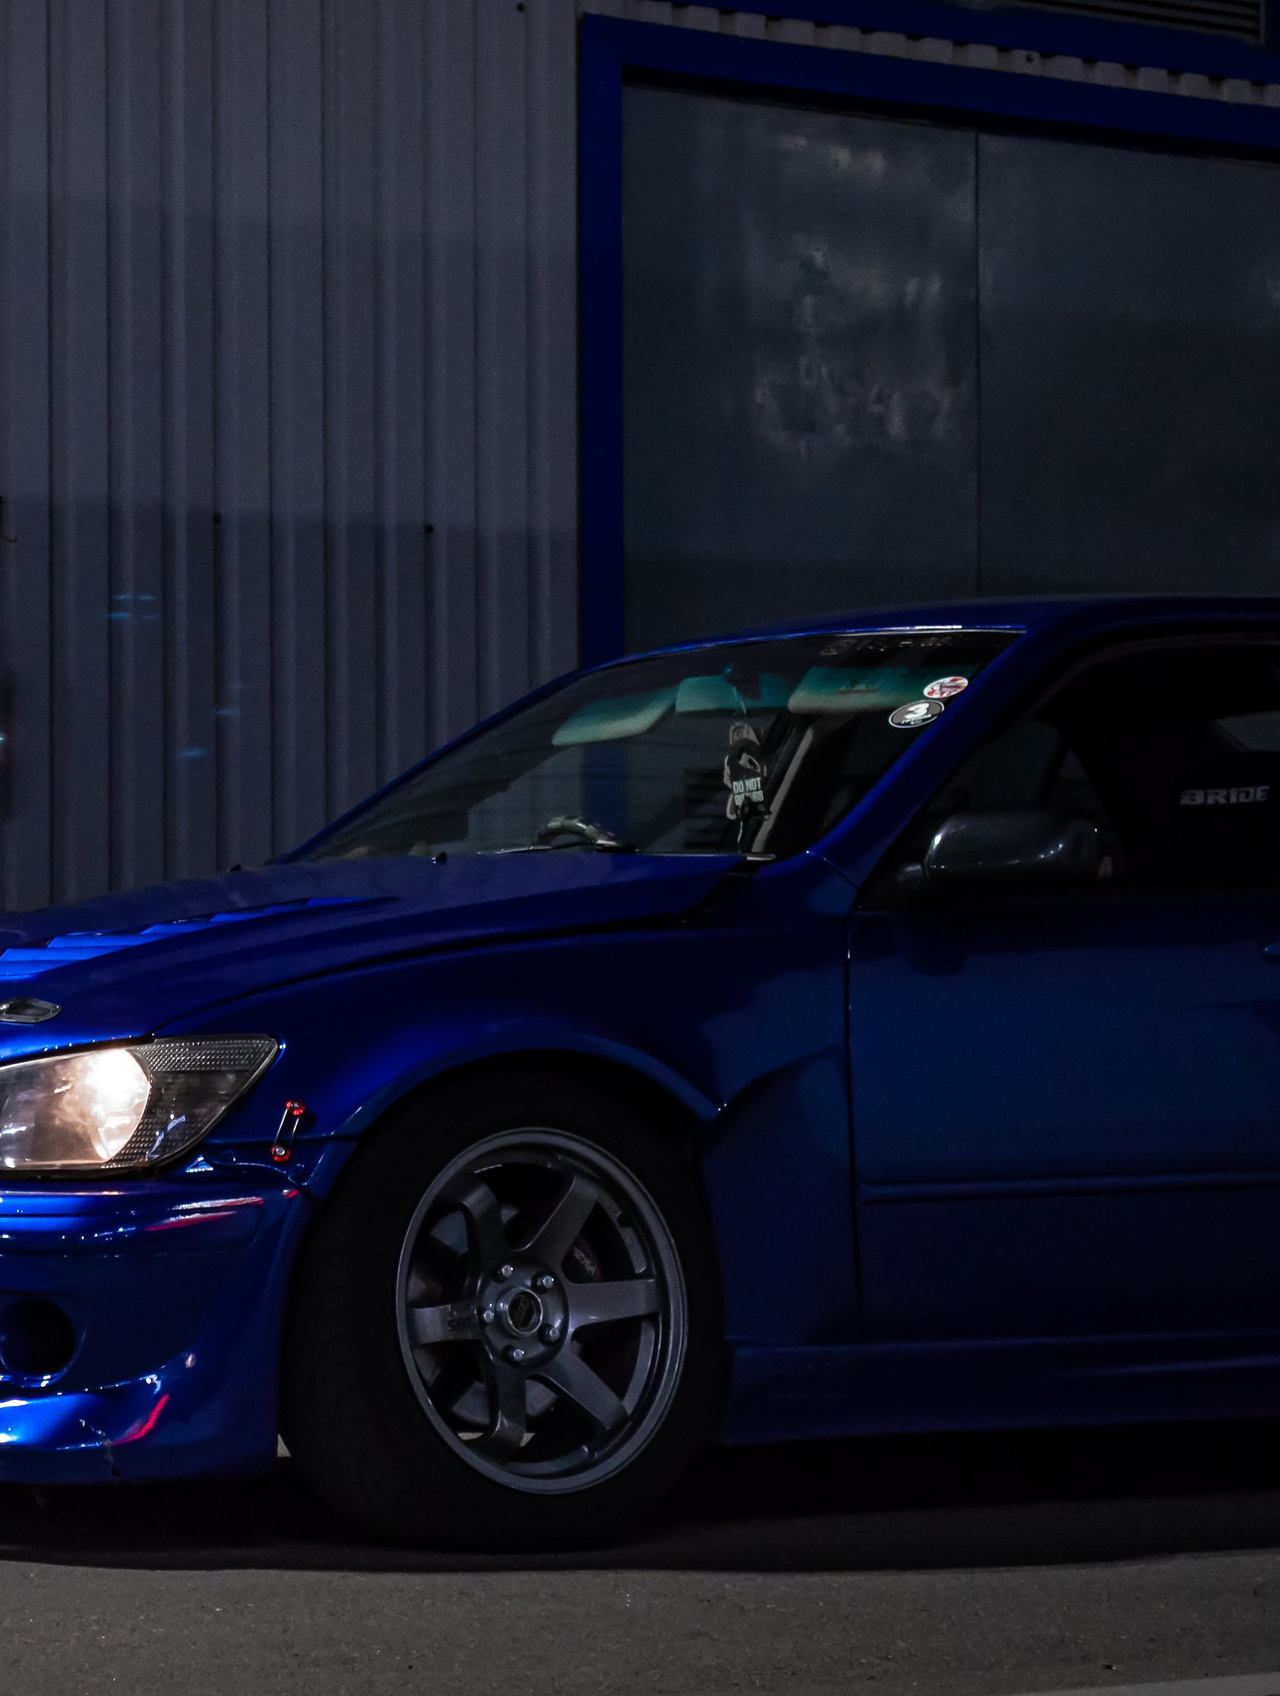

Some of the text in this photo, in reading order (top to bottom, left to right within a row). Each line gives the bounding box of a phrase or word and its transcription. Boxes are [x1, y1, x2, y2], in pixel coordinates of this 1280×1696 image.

[733, 777, 762, 794] DO NOT
[1180, 785, 1270, 805] BRIDE
